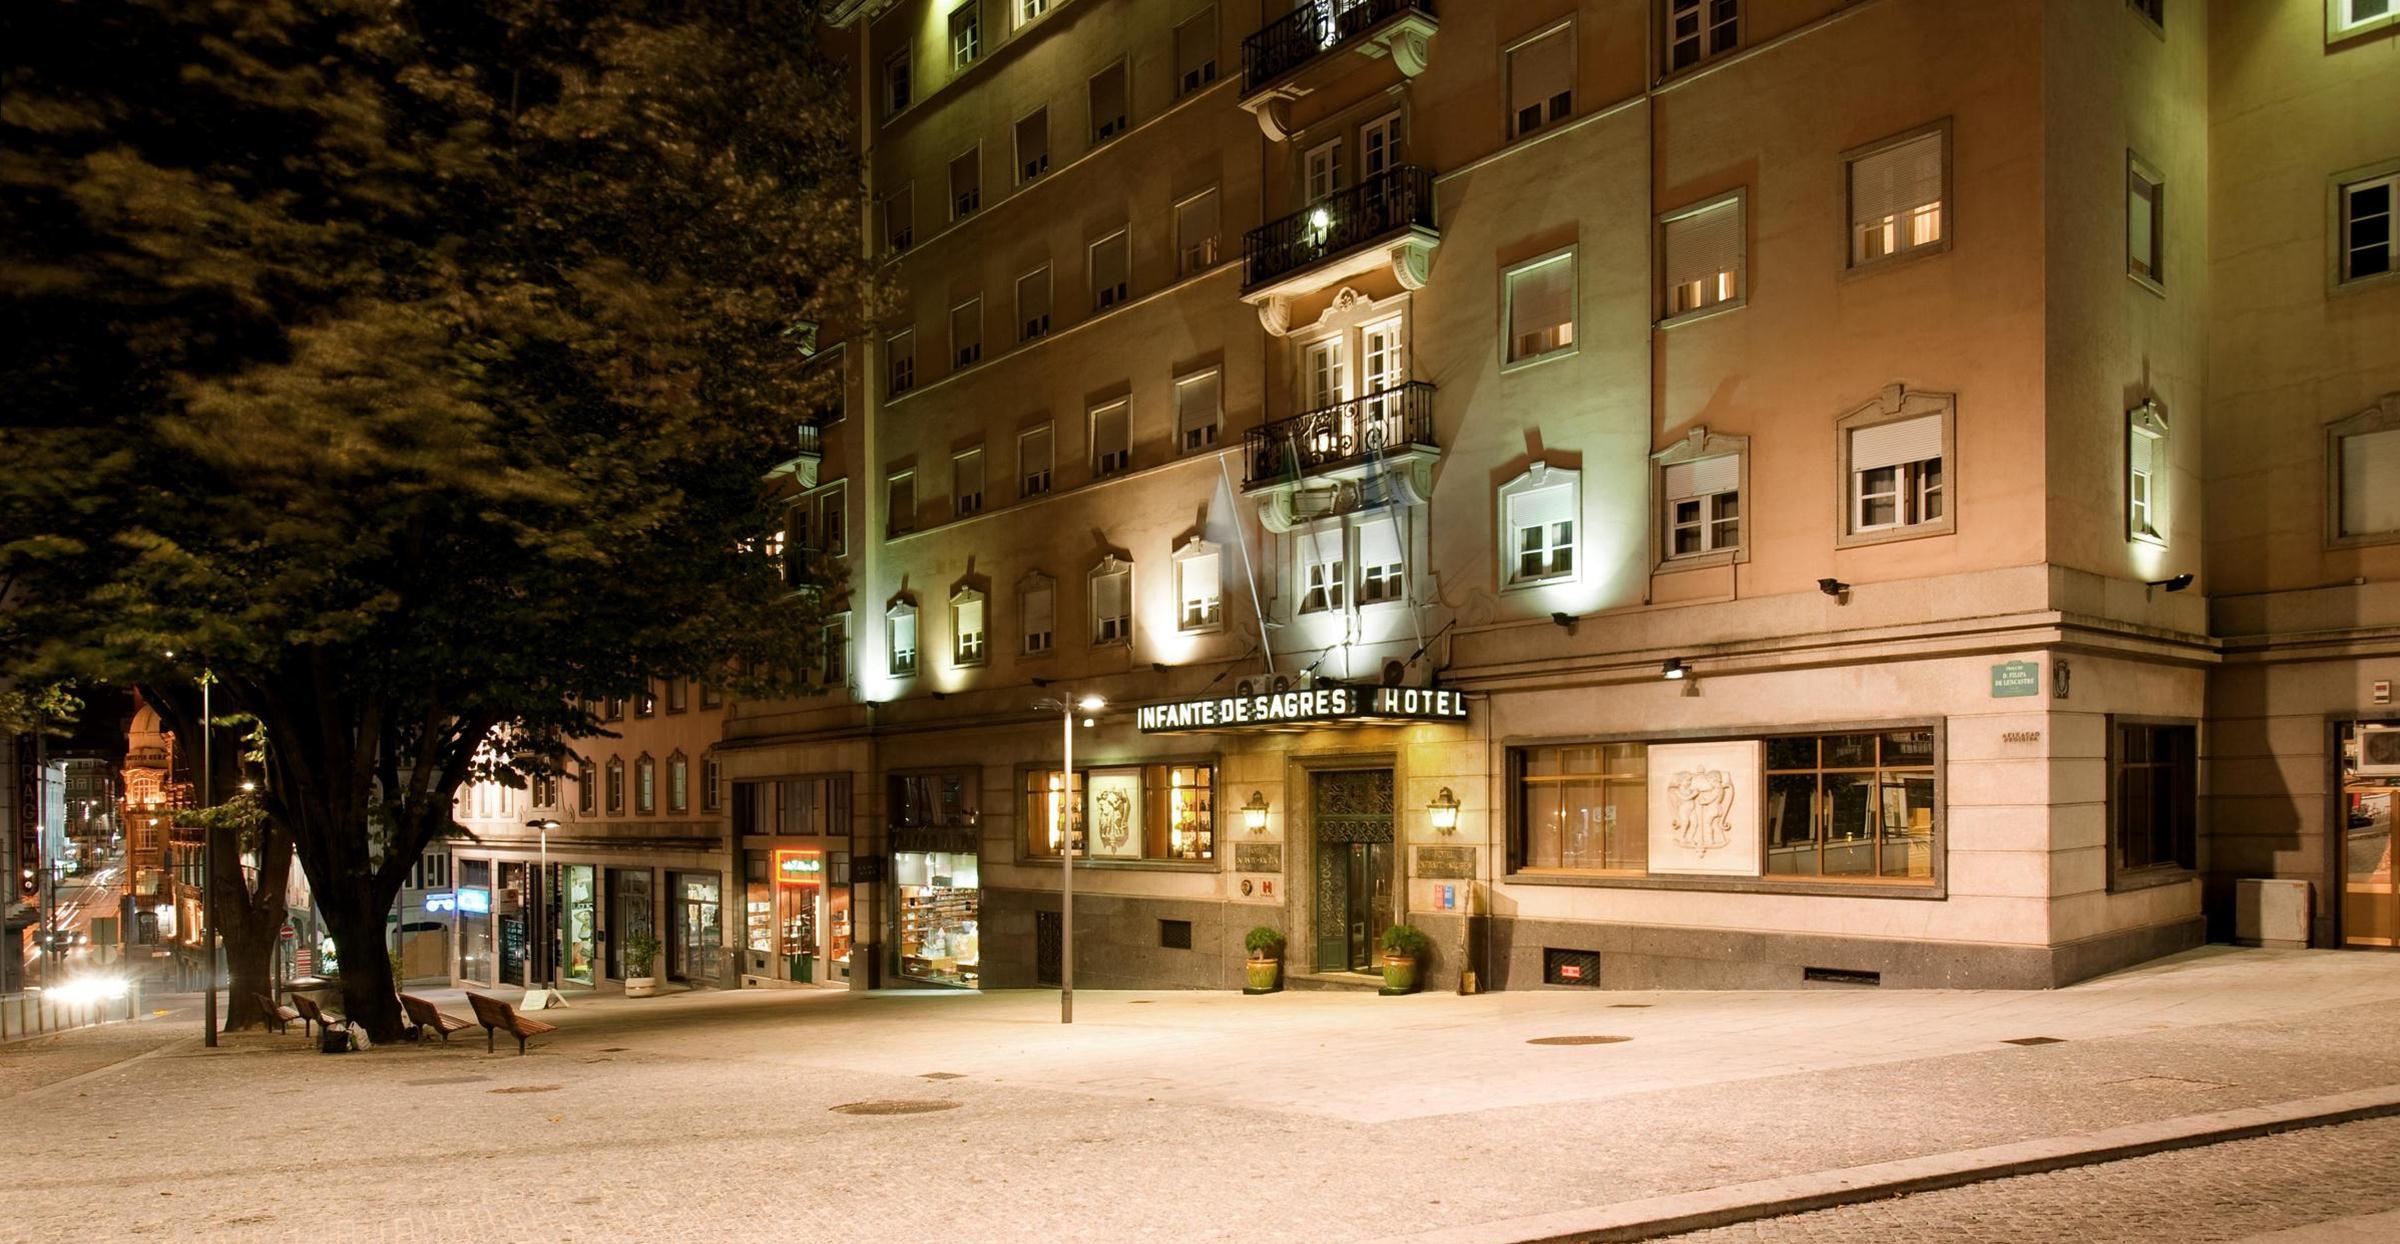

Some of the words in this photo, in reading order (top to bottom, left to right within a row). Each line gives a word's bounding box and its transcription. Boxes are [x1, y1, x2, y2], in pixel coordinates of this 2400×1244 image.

[1137, 701, 1214, 730] INFANTE
[1221, 698, 1248, 724] DE
[1256, 688, 1347, 720] SAGRES
[1384, 687, 1467, 717] HOTEL
[22, 735, 36, 860] ARAGEM
